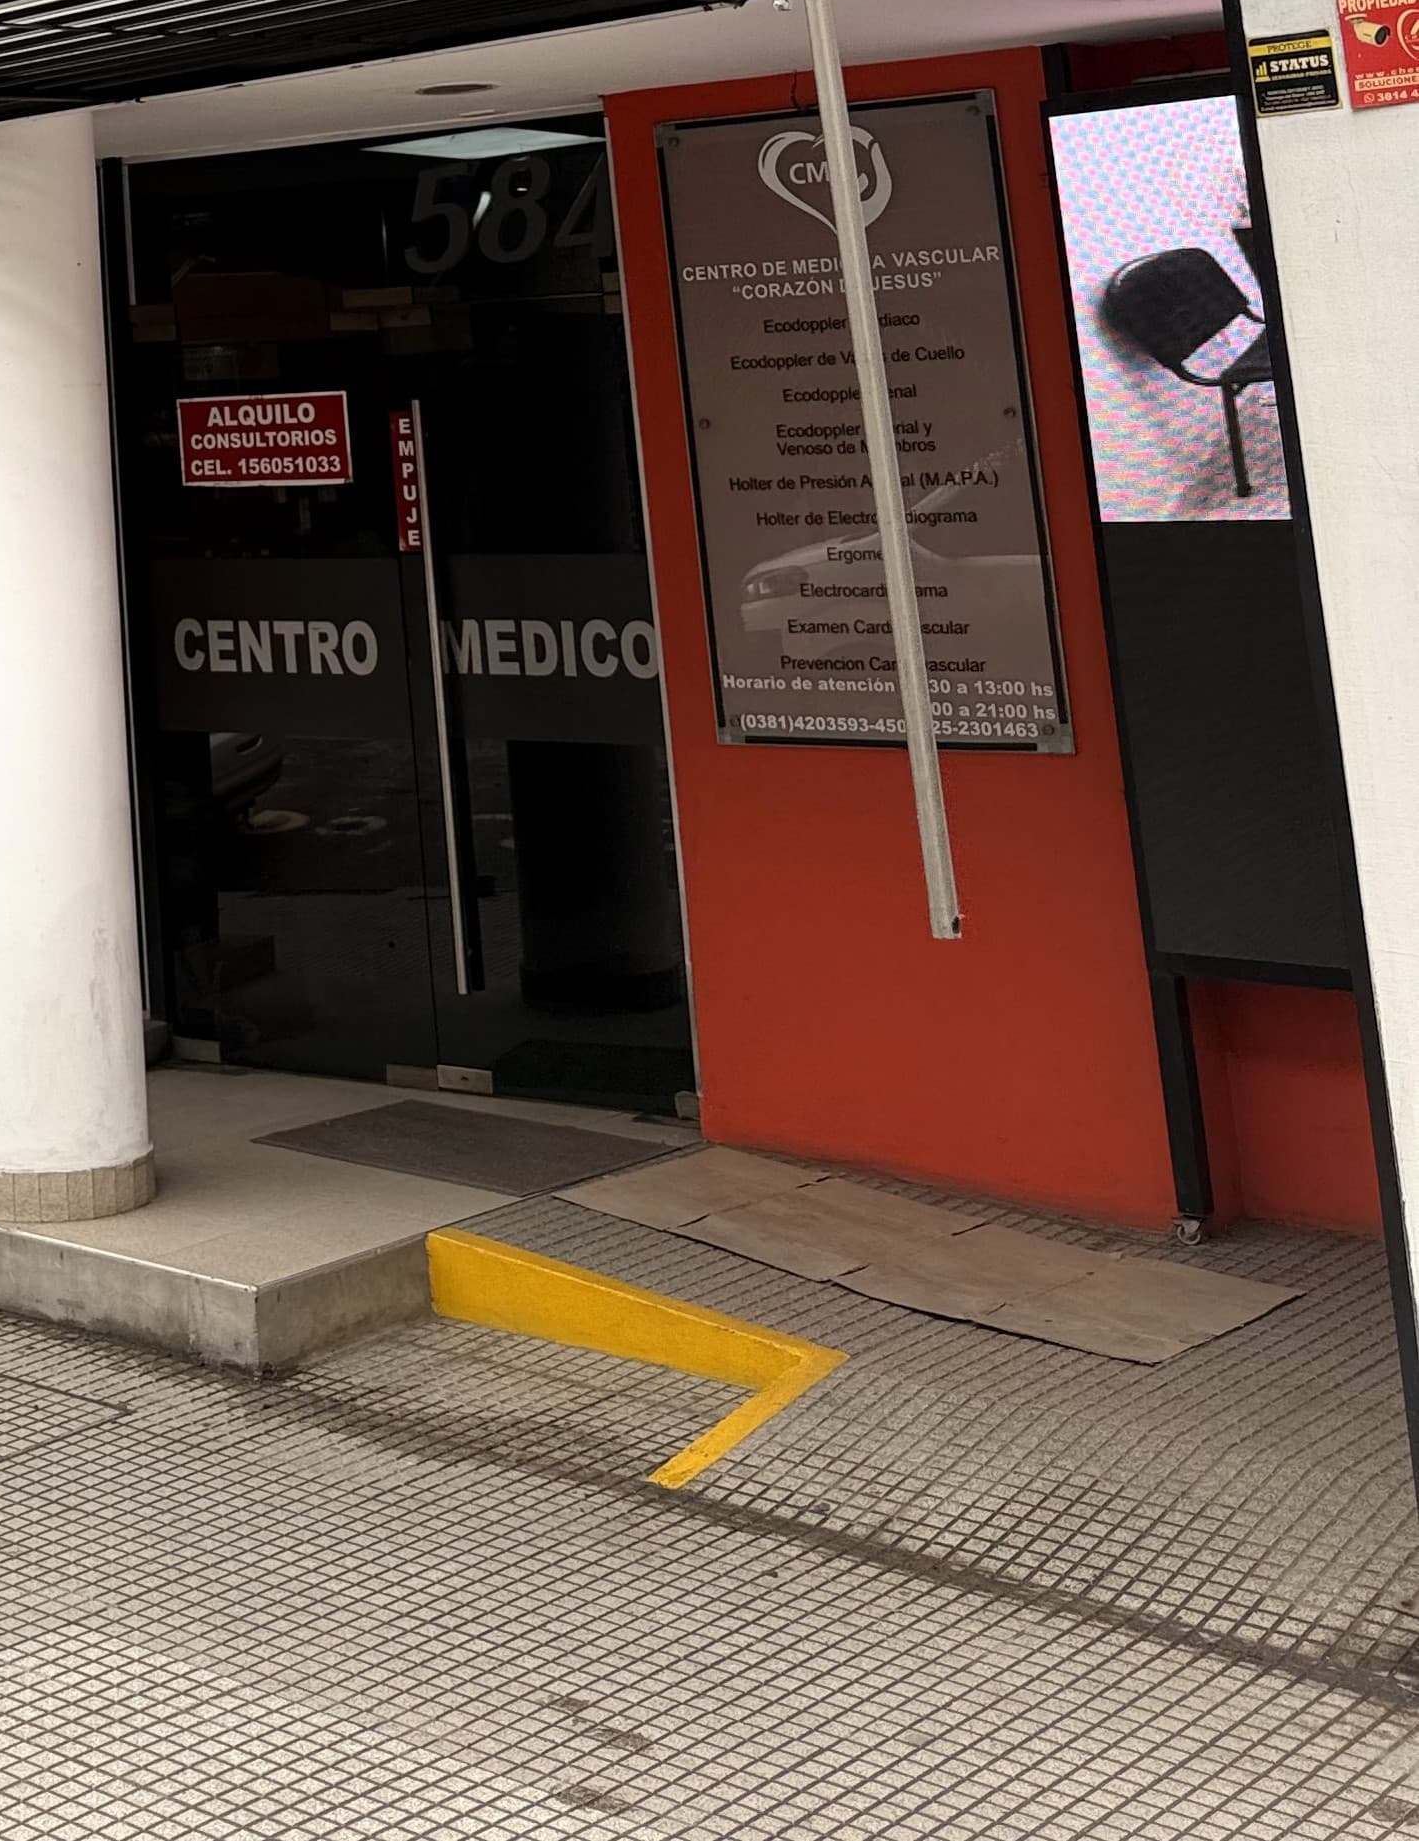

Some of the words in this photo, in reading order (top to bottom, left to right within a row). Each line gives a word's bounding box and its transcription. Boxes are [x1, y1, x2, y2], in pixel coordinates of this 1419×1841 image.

[1270, 54, 1329, 73] STATUS
[1377, 91, 1408, 102] 3814
[789, 161, 831, 185] CM
[403, 152, 617, 274] 584
[682, 262, 758, 281] CENTRO
[762, 261, 788, 276] DE
[792, 254, 886, 275] MEDIA
[891, 246, 1000, 268] VASCULAR
[763, 316, 847, 335] Ecodoppler
[731, 353, 814, 371] Ecodoppler
[817, 352, 836, 366] de
[891, 347, 911, 362] de
[914, 345, 966, 361] Cuello
[783, 387, 860, 403] Ecodopple
[887, 383, 918, 399] enal
[206, 402, 316, 428] ALQUILO
[190, 428, 338, 451] CONSULTORIOS
[776, 423, 862, 440] Ecodoppler
[923, 422, 932, 437] y
[776, 442, 834, 456] Venoso
[837, 440, 856, 454] de
[190, 458, 233, 477] CEL.
[237, 455, 341, 476] 156051033
[398, 417, 422, 548] EMPUJE
[729, 475, 773, 491] Holter
[776, 476, 796, 490] de
[800, 474, 856, 490] Presión
[919, 471, 999, 490] (M.A.P.A.)
[756, 512, 801, 527] Holter
[805, 511, 824, 525] de
[828, 510, 978, 527] Electrodiograma
[827, 547, 883, 564] Ergome
[787, 619, 850, 635] Examen
[174, 618, 379, 677] CENTRO
[440, 618, 659, 680] MEDICO
[723, 674, 787, 689] Horario
[791, 676, 813, 690] de
[818, 676, 896, 692] atención
[956, 683, 968, 695] a
[974, 680, 1025, 696] 13:00
[1031, 682, 1054, 697] hs
[958, 706, 971, 717] a
[975, 703, 1027, 719] 21:00
[1033, 705, 1056, 720] hs
